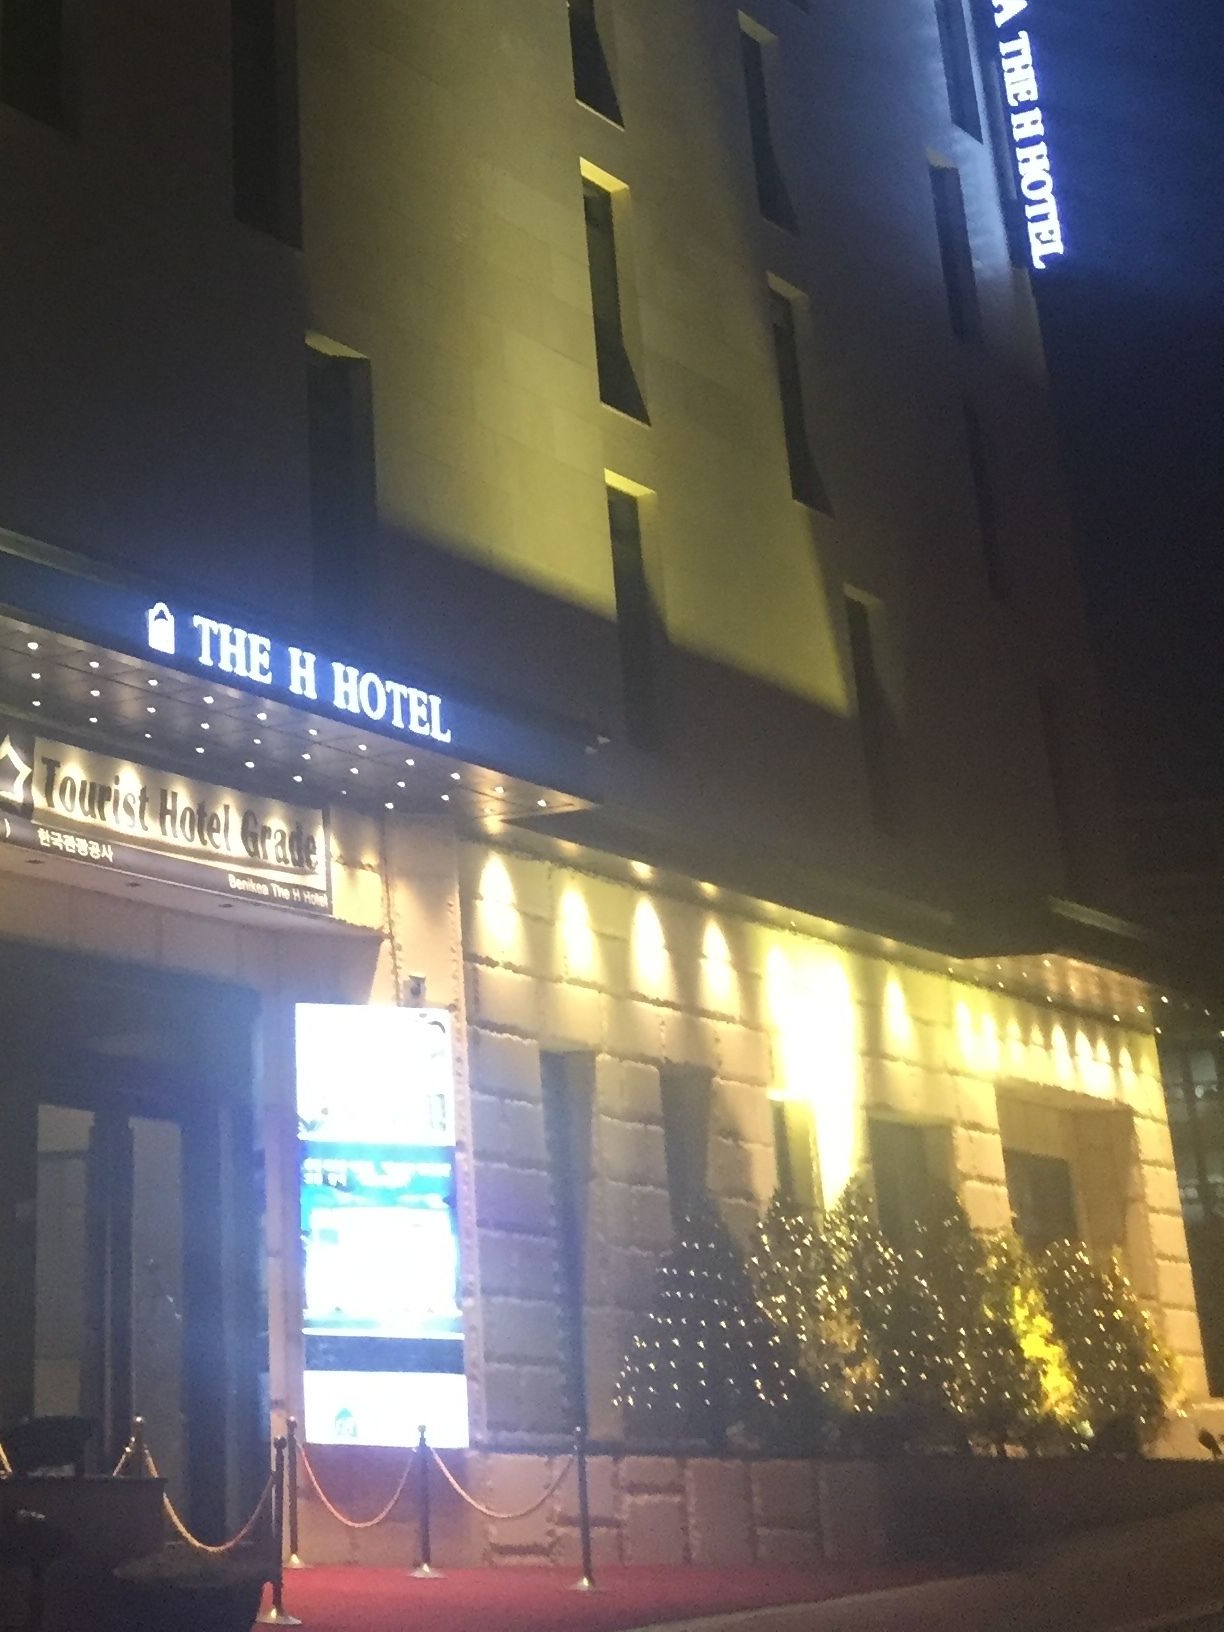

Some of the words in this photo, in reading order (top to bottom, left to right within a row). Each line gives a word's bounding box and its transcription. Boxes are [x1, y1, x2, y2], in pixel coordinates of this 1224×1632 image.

[999, 30, 1039, 107] THE
[1011, 106, 1045, 142] H
[1016, 141, 1064, 269] HOTEL
[192, 614, 272, 684] THE
[288, 646, 318, 700] H
[332, 661, 451, 743] HOTEL
[37, 826, 114, 863] 한국관광공사
[41, 756, 149, 832] Tourist
[159, 788, 231, 851] Hotel
[241, 809, 318, 869] Grade
[228, 873, 269, 896] Benikea
[270, 882, 291, 900] The
[292, 887, 301, 902] H
